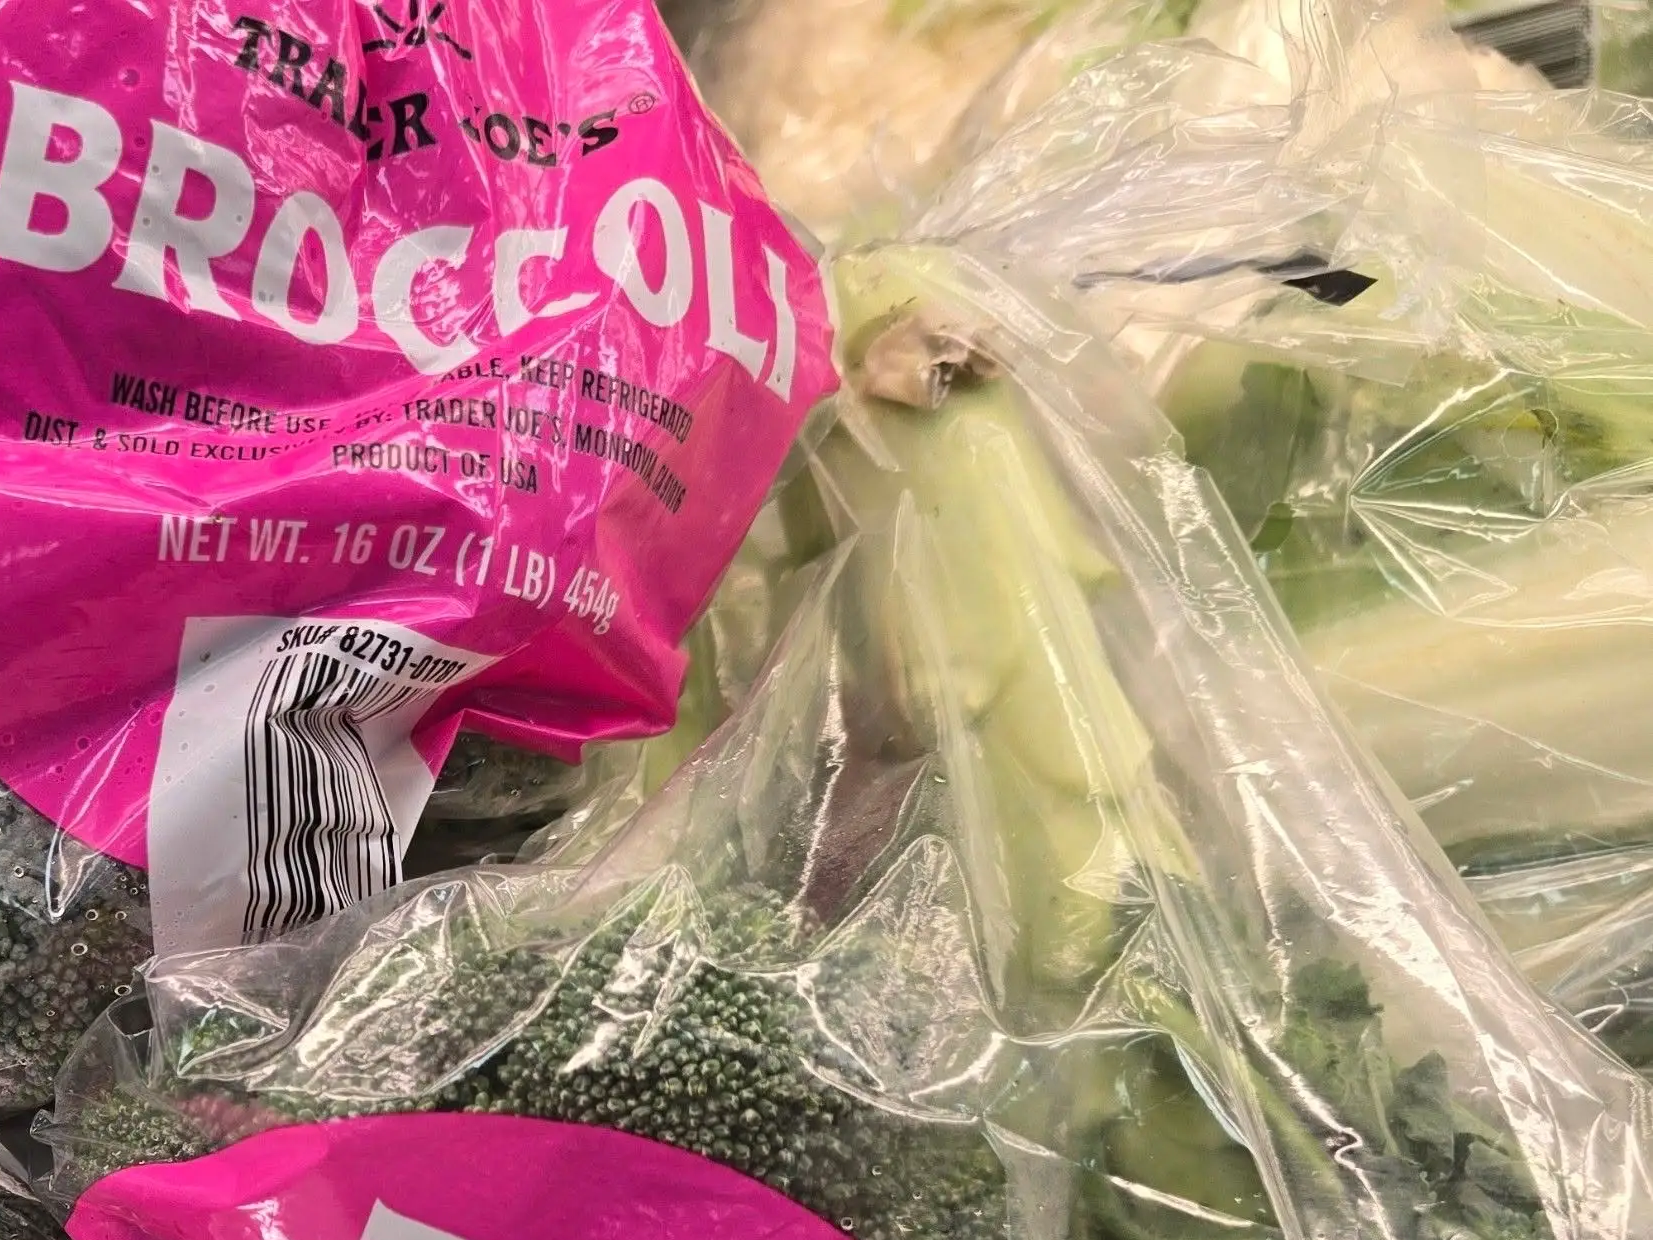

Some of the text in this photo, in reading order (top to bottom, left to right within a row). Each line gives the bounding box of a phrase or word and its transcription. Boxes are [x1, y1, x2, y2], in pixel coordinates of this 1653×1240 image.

[234, 16, 436, 161] TRAER
[93, 427, 109, 451] &
[117, 434, 180, 457] SOLD
[402, 397, 497, 431] TRADER
[112, 372, 178, 417] WASH
[184, 391, 277, 434] BEFORE
[519, 355, 576, 391] KEEP
[580, 367, 695, 445] REFRIGERATED
[333, 443, 538, 495] PRODUCT OF USA
[158, 515, 621, 635] NET WT. 16 OZ (1 LB) 454g
[276, 625, 341, 653] SKU#
